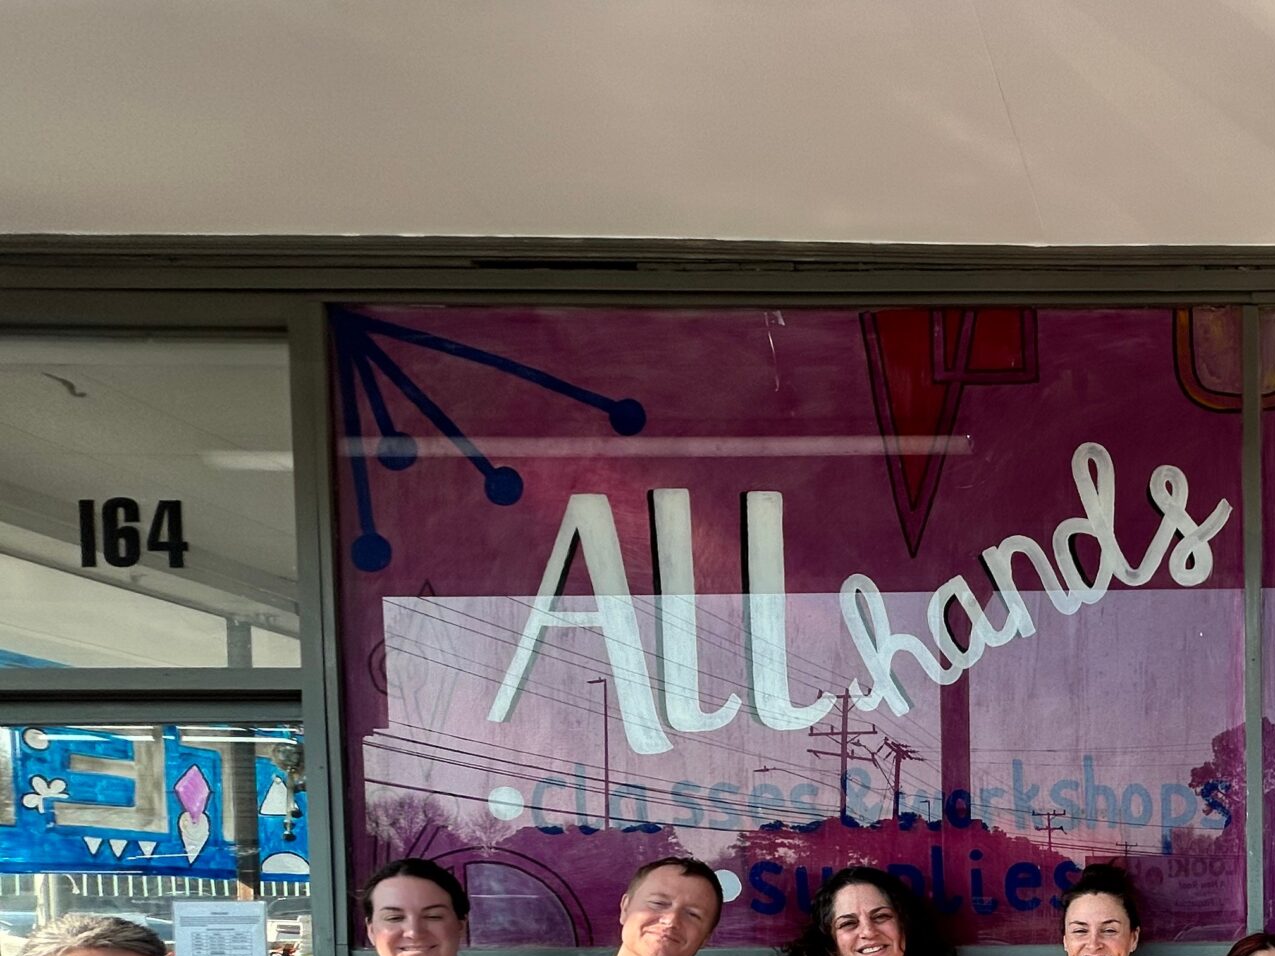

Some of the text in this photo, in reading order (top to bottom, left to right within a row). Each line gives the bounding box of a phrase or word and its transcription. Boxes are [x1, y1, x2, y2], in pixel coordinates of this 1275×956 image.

[79, 497, 188, 568] 164
[488, 442, 1233, 754] All hands
[532, 762, 820, 835] classes
[893, 754, 1233, 855] workshops
